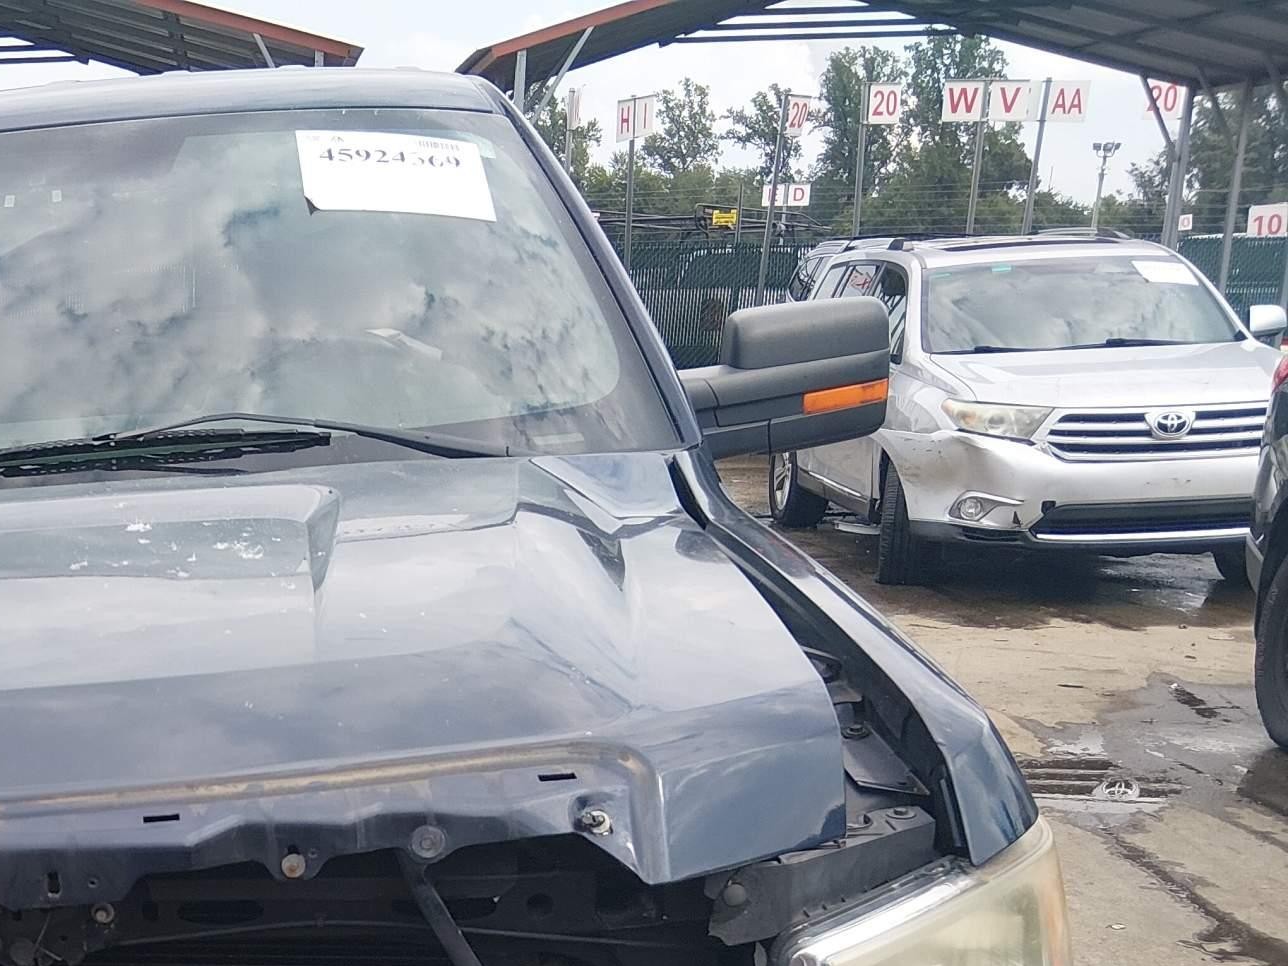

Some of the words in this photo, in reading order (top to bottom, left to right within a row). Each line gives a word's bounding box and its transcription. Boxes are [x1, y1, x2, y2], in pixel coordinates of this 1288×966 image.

[871, 90, 898, 117] 20
[948, 87, 979, 114] W
[1000, 87, 1021, 114] V
[1051, 88, 1083, 115] AA
[1145, 83, 1178, 112] 20
[620, 107, 630, 134] H
[788, 102, 808, 129] 20
[793, 187, 805, 201] D
[1253, 213, 1282, 236] 10
